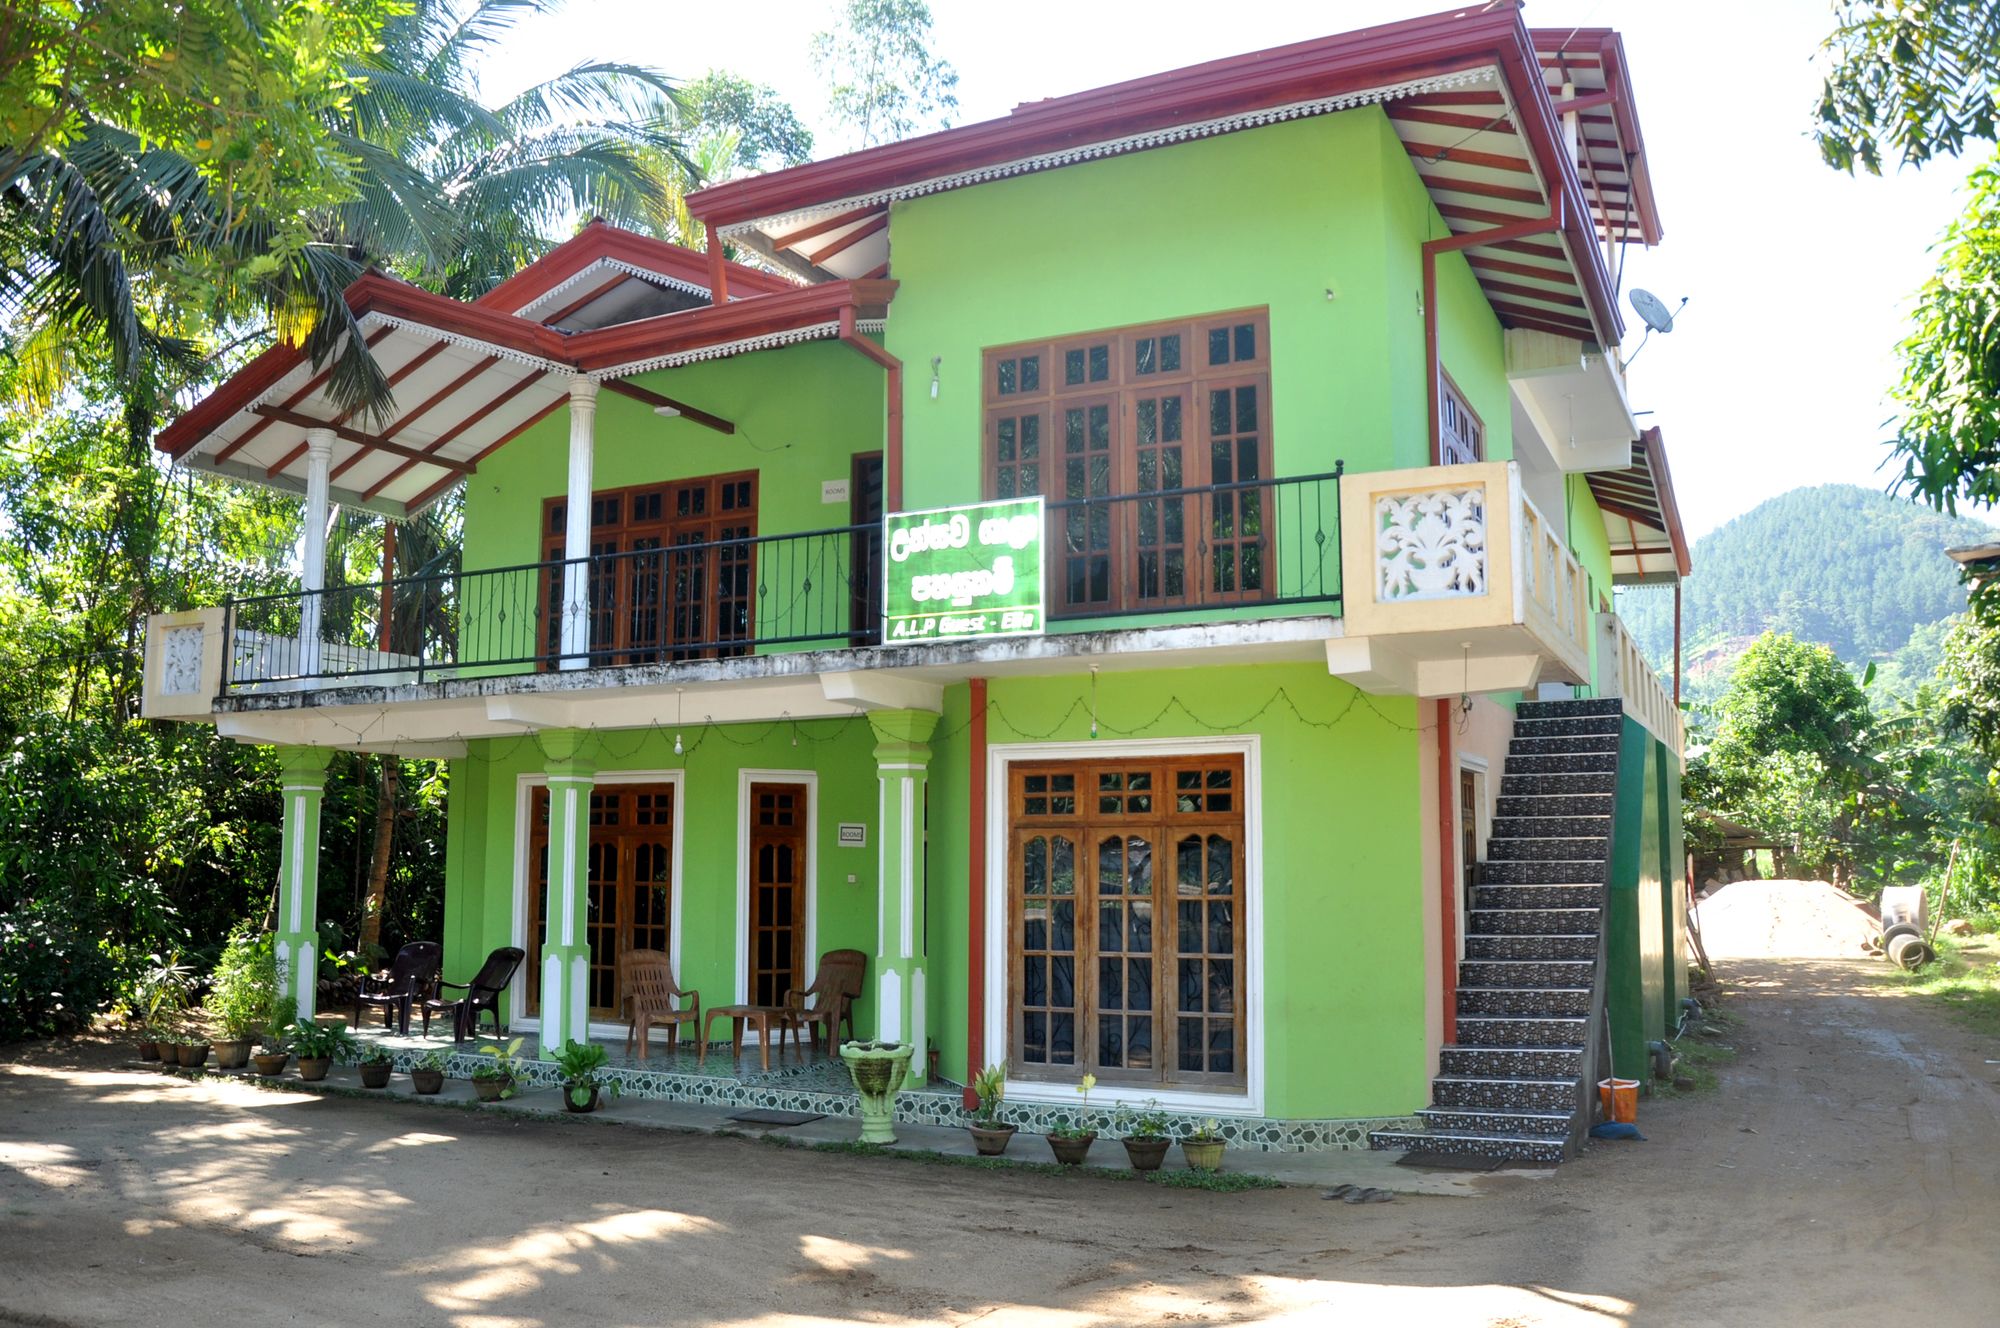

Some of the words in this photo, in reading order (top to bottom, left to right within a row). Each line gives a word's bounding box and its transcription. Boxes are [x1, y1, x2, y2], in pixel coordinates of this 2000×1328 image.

[893, 618, 936, 637] A.L.P
[939, 614, 987, 633] Guest
[1001, 611, 1034, 629] Ella
